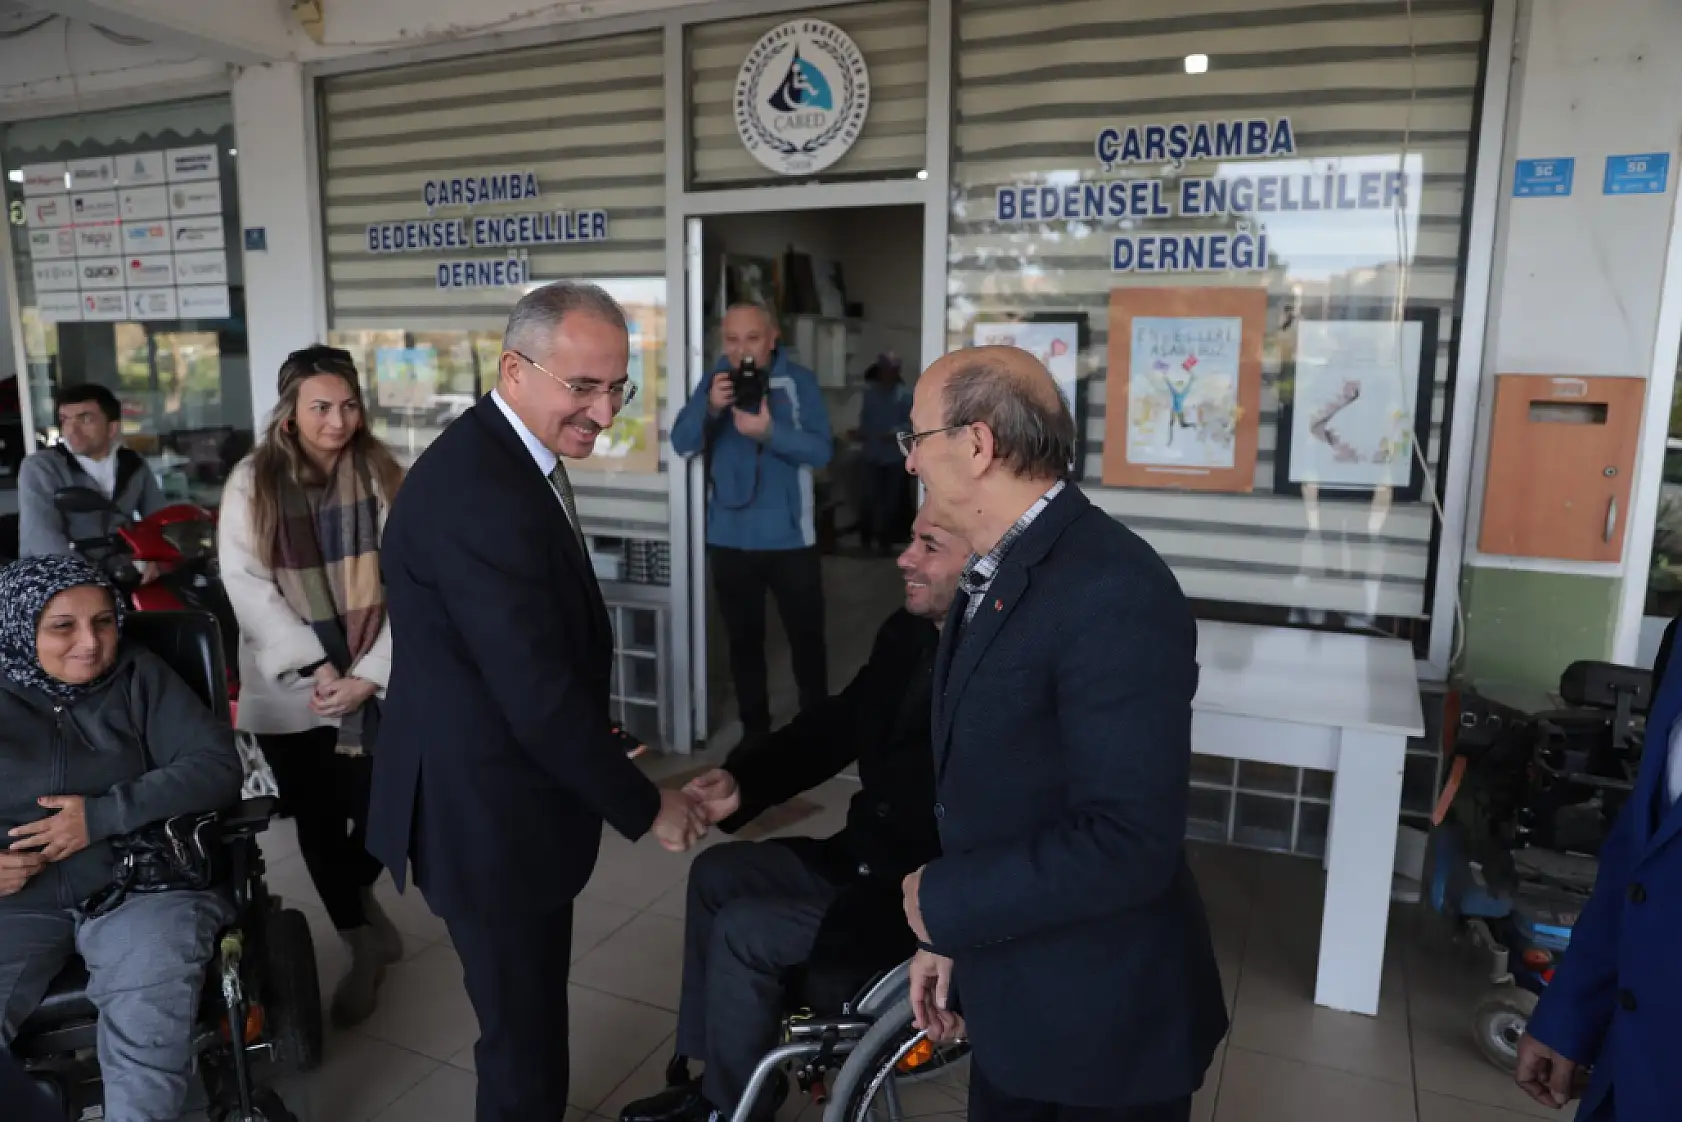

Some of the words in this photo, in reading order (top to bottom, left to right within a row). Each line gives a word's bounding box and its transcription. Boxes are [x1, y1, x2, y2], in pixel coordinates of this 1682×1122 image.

[1099, 118, 1293, 172] ÇARŞAMBA
[999, 182, 1168, 220] BEDENSEL
[1182, 163, 1408, 213] ENGELLİLER
[369, 220, 468, 250] BEDENSEL
[475, 207, 607, 245] ENGELLİLER
[1114, 222, 1268, 269] DERNEĞİ
